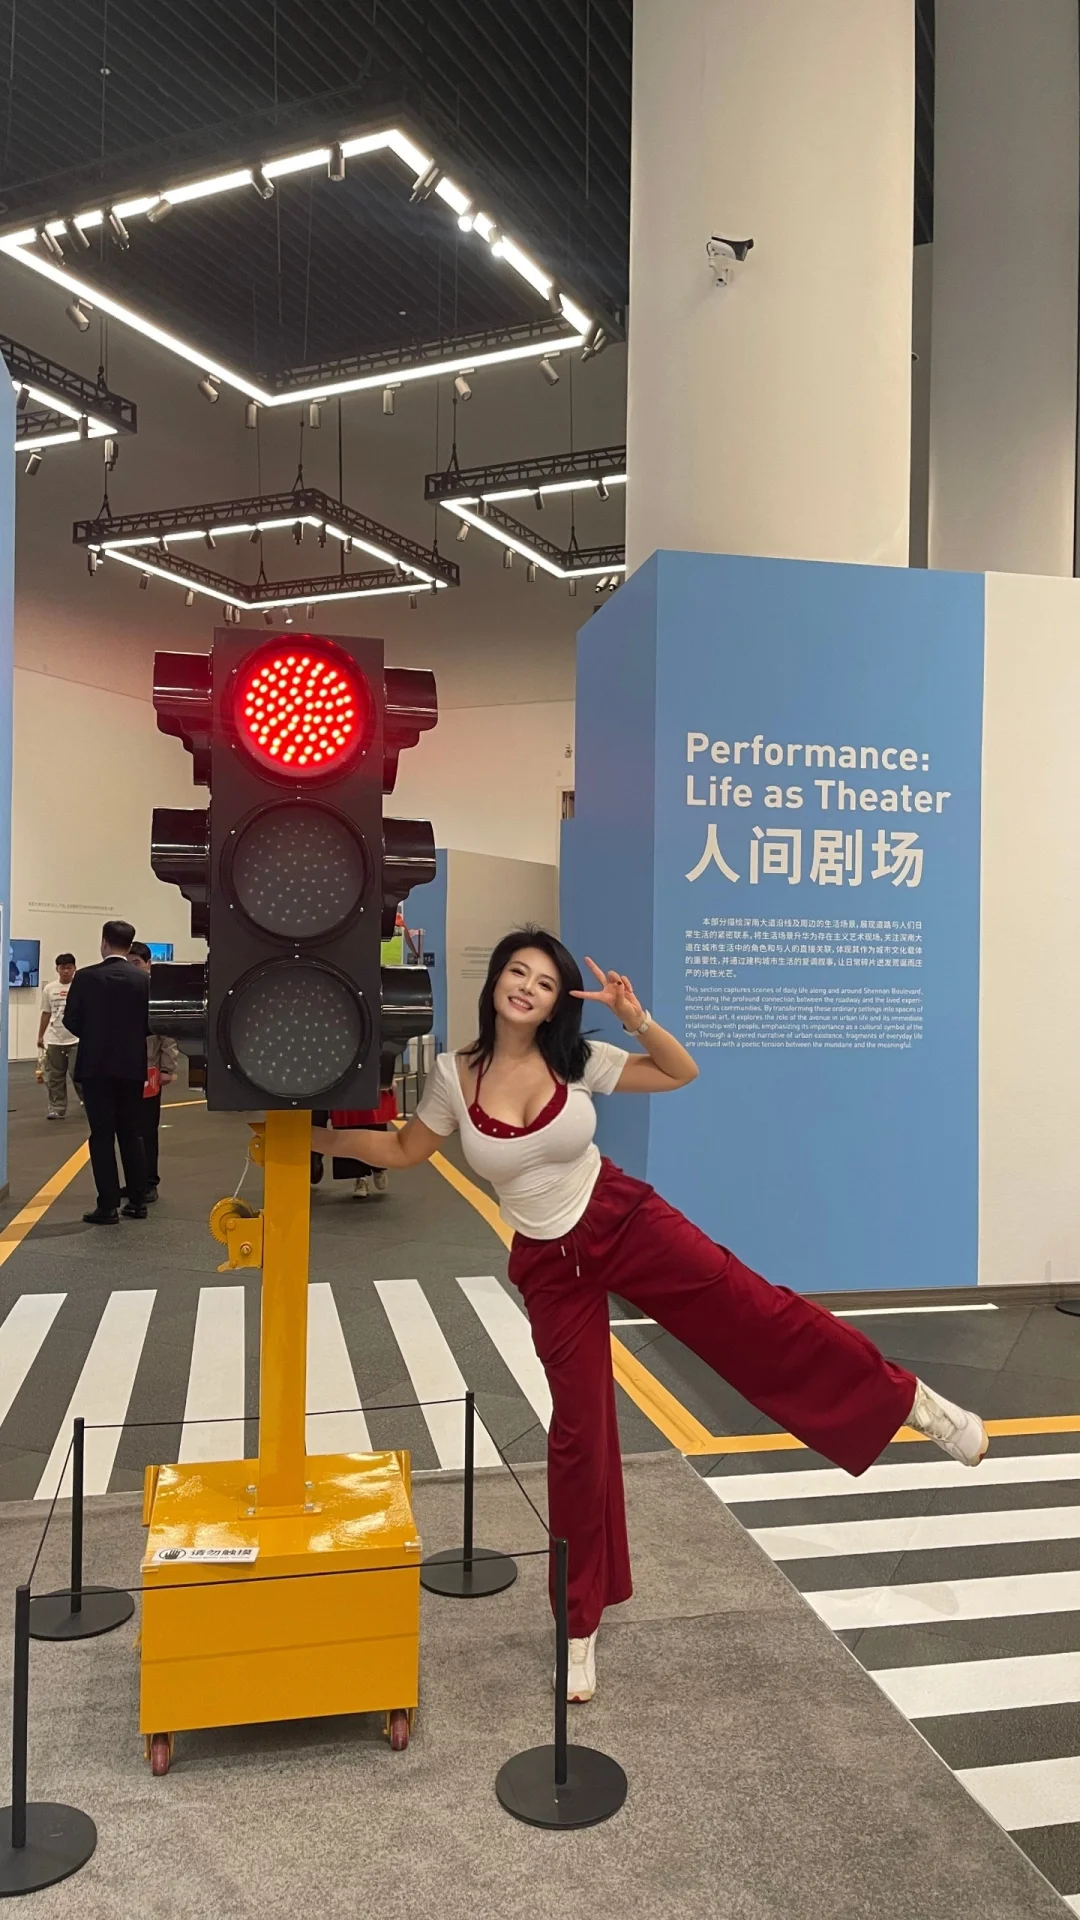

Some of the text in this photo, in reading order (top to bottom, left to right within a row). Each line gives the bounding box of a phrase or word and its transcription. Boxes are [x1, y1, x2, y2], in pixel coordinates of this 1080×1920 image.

[686, 732, 930, 772] Performance:
[686, 775, 952, 814] Life as Theater
[685, 823, 924, 888] 人间剧场
